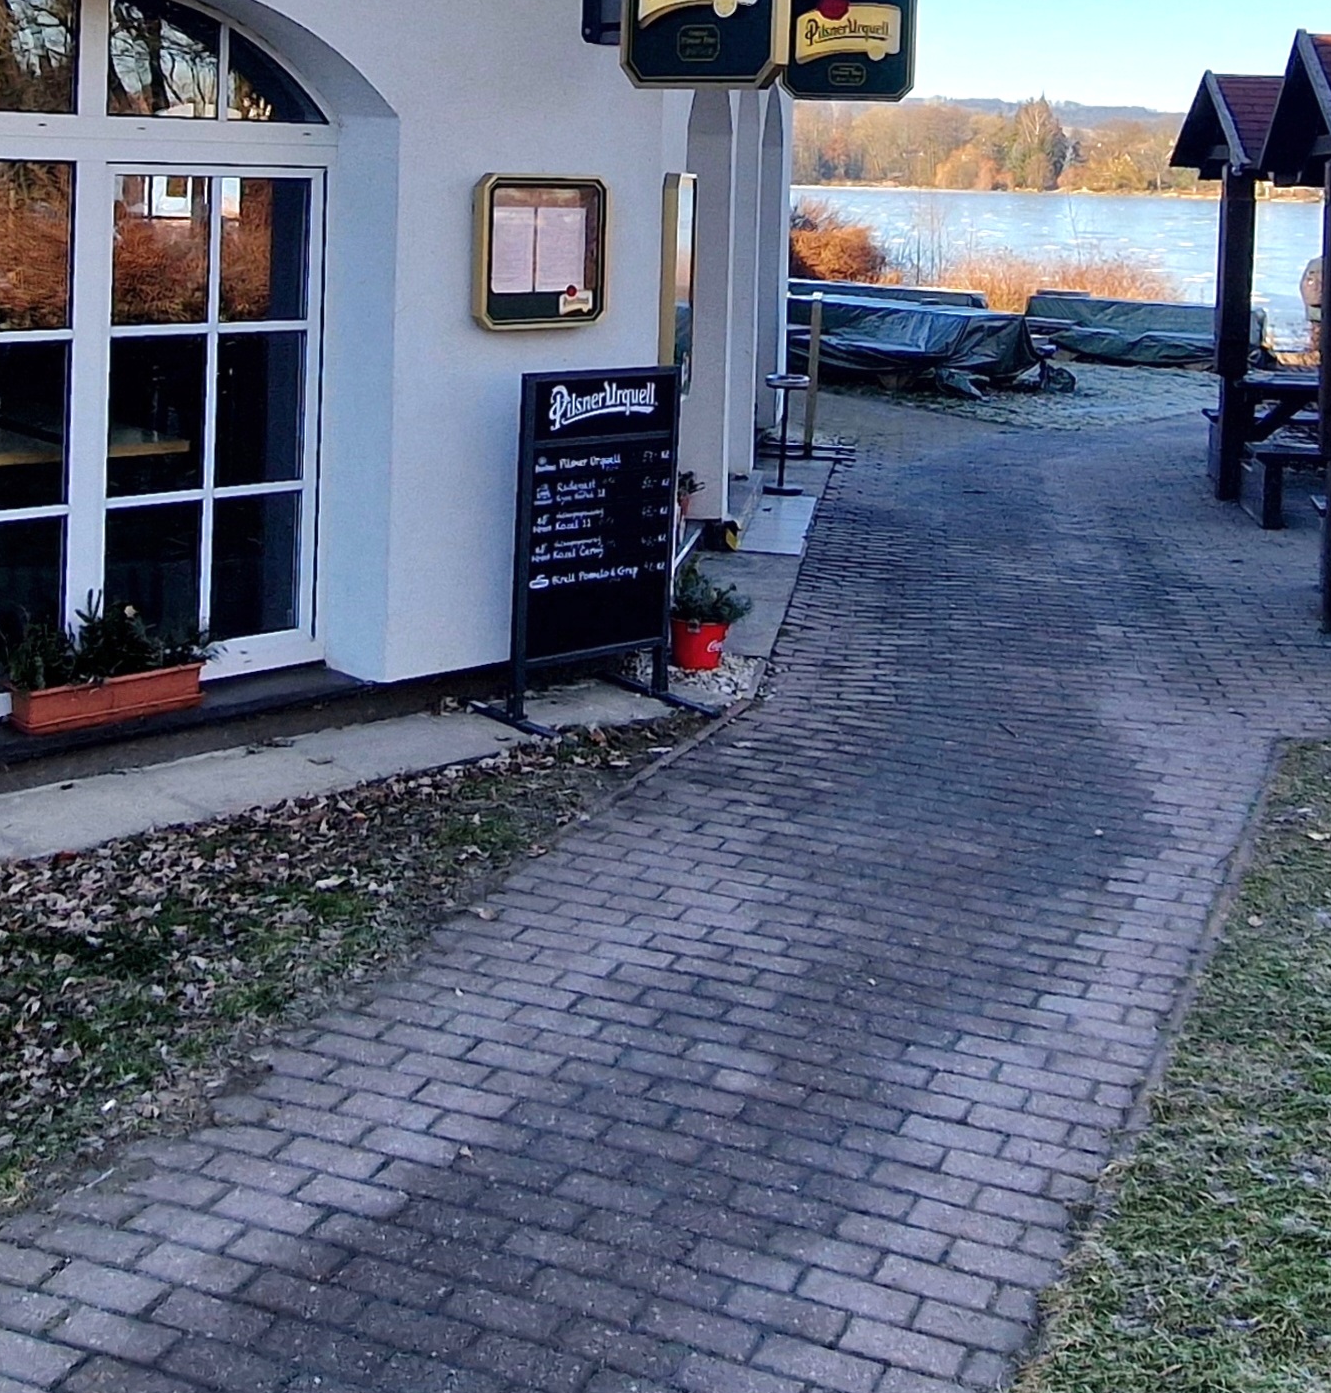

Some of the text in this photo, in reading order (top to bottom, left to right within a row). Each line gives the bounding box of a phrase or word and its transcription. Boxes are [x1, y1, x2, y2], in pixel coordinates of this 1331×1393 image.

[805, 18, 889, 46] Pilsner Urquell
[549, 381, 656, 431] Pilsner Urquell
